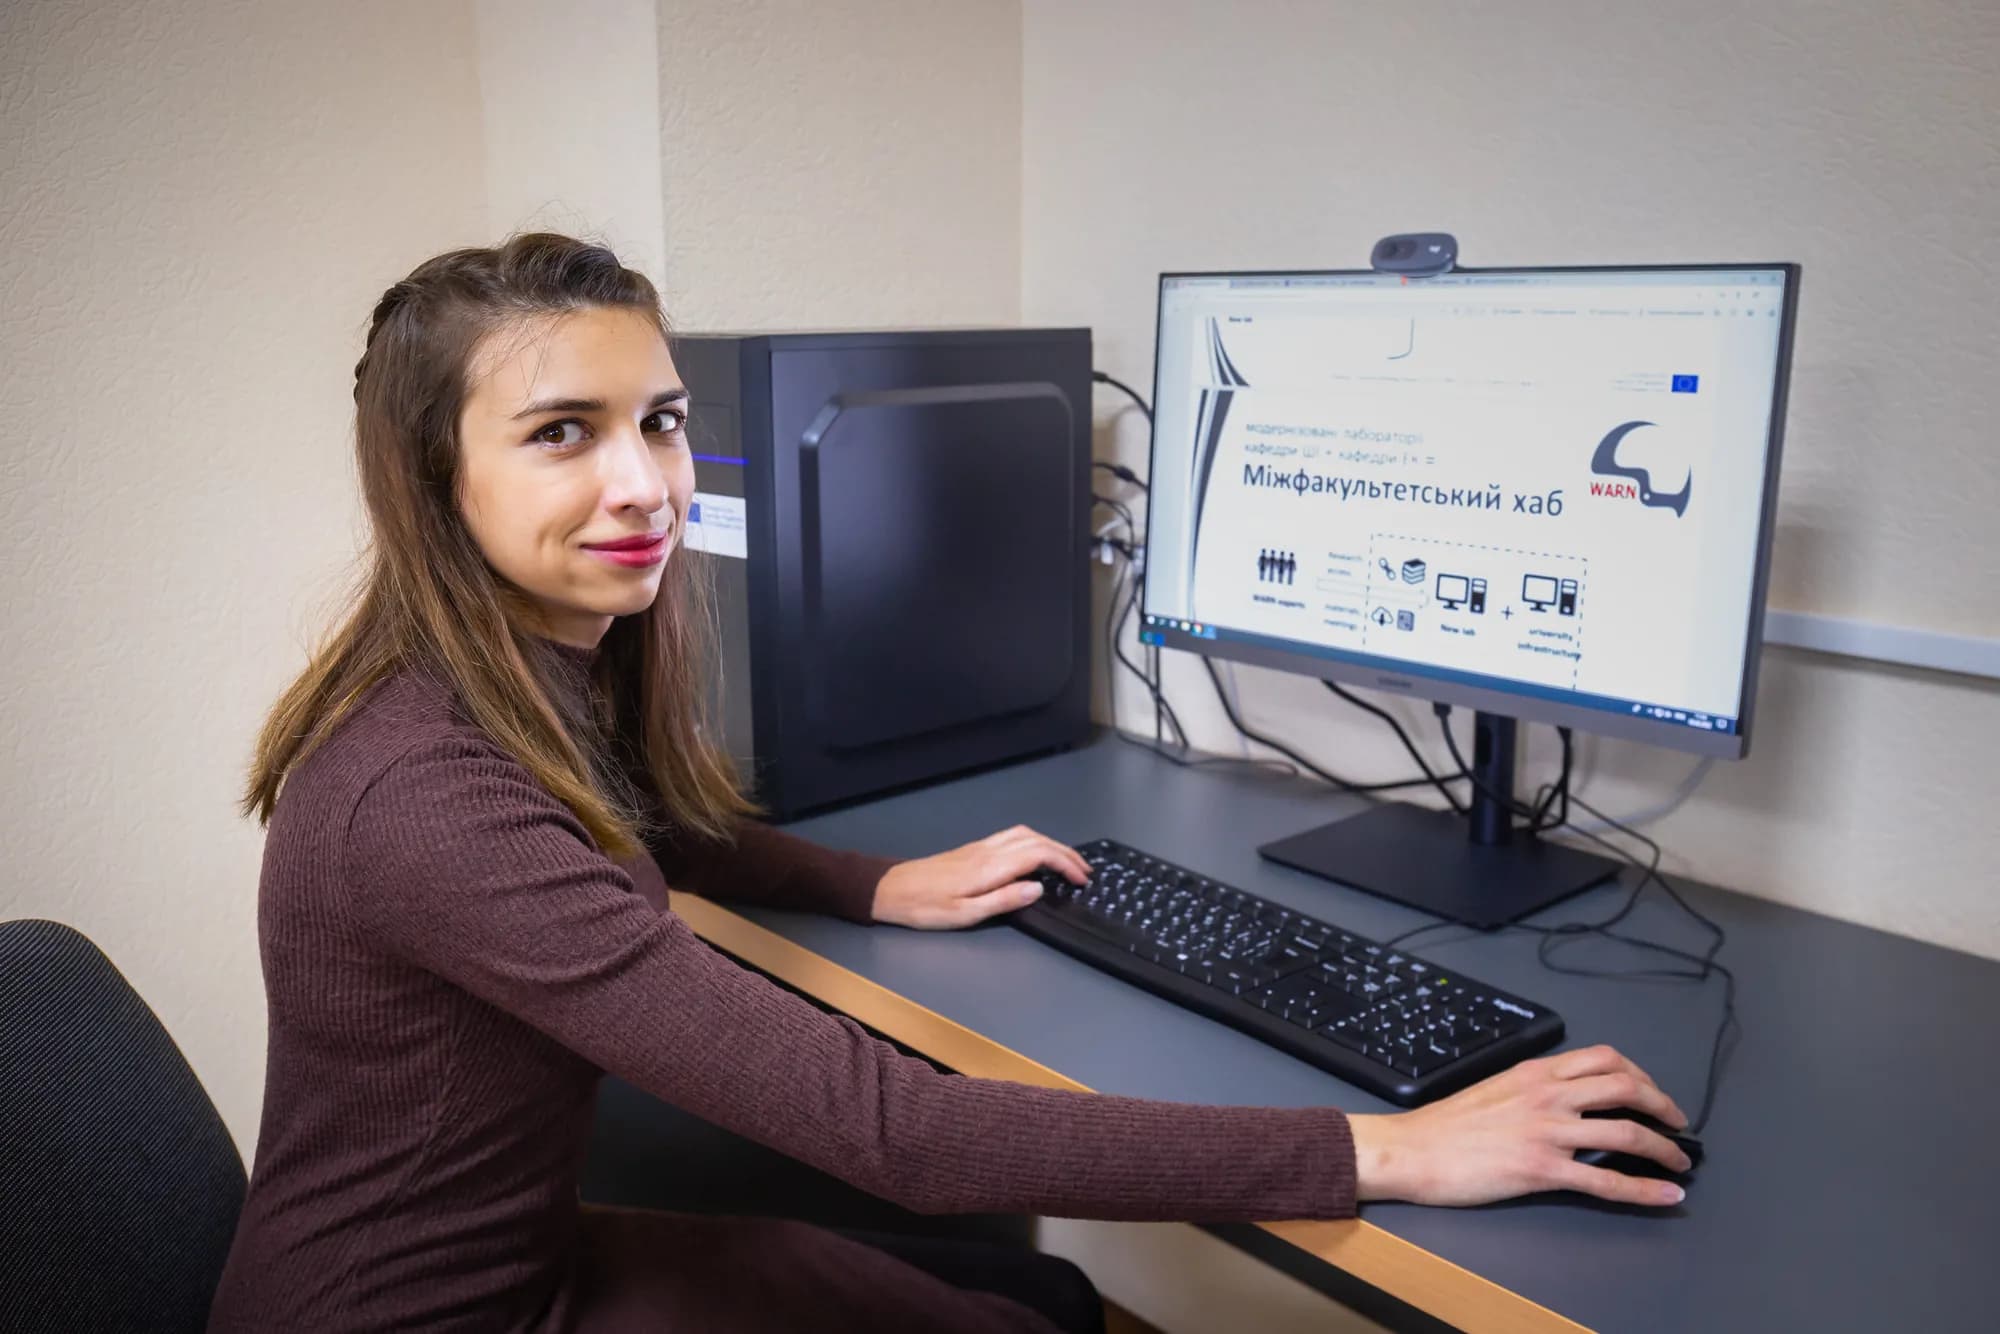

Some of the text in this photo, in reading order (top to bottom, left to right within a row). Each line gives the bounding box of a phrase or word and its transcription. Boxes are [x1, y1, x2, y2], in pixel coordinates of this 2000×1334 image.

[1243, 463, 1564, 517] Міжфакультетський хаб
[1590, 482, 1637, 500] WARN
